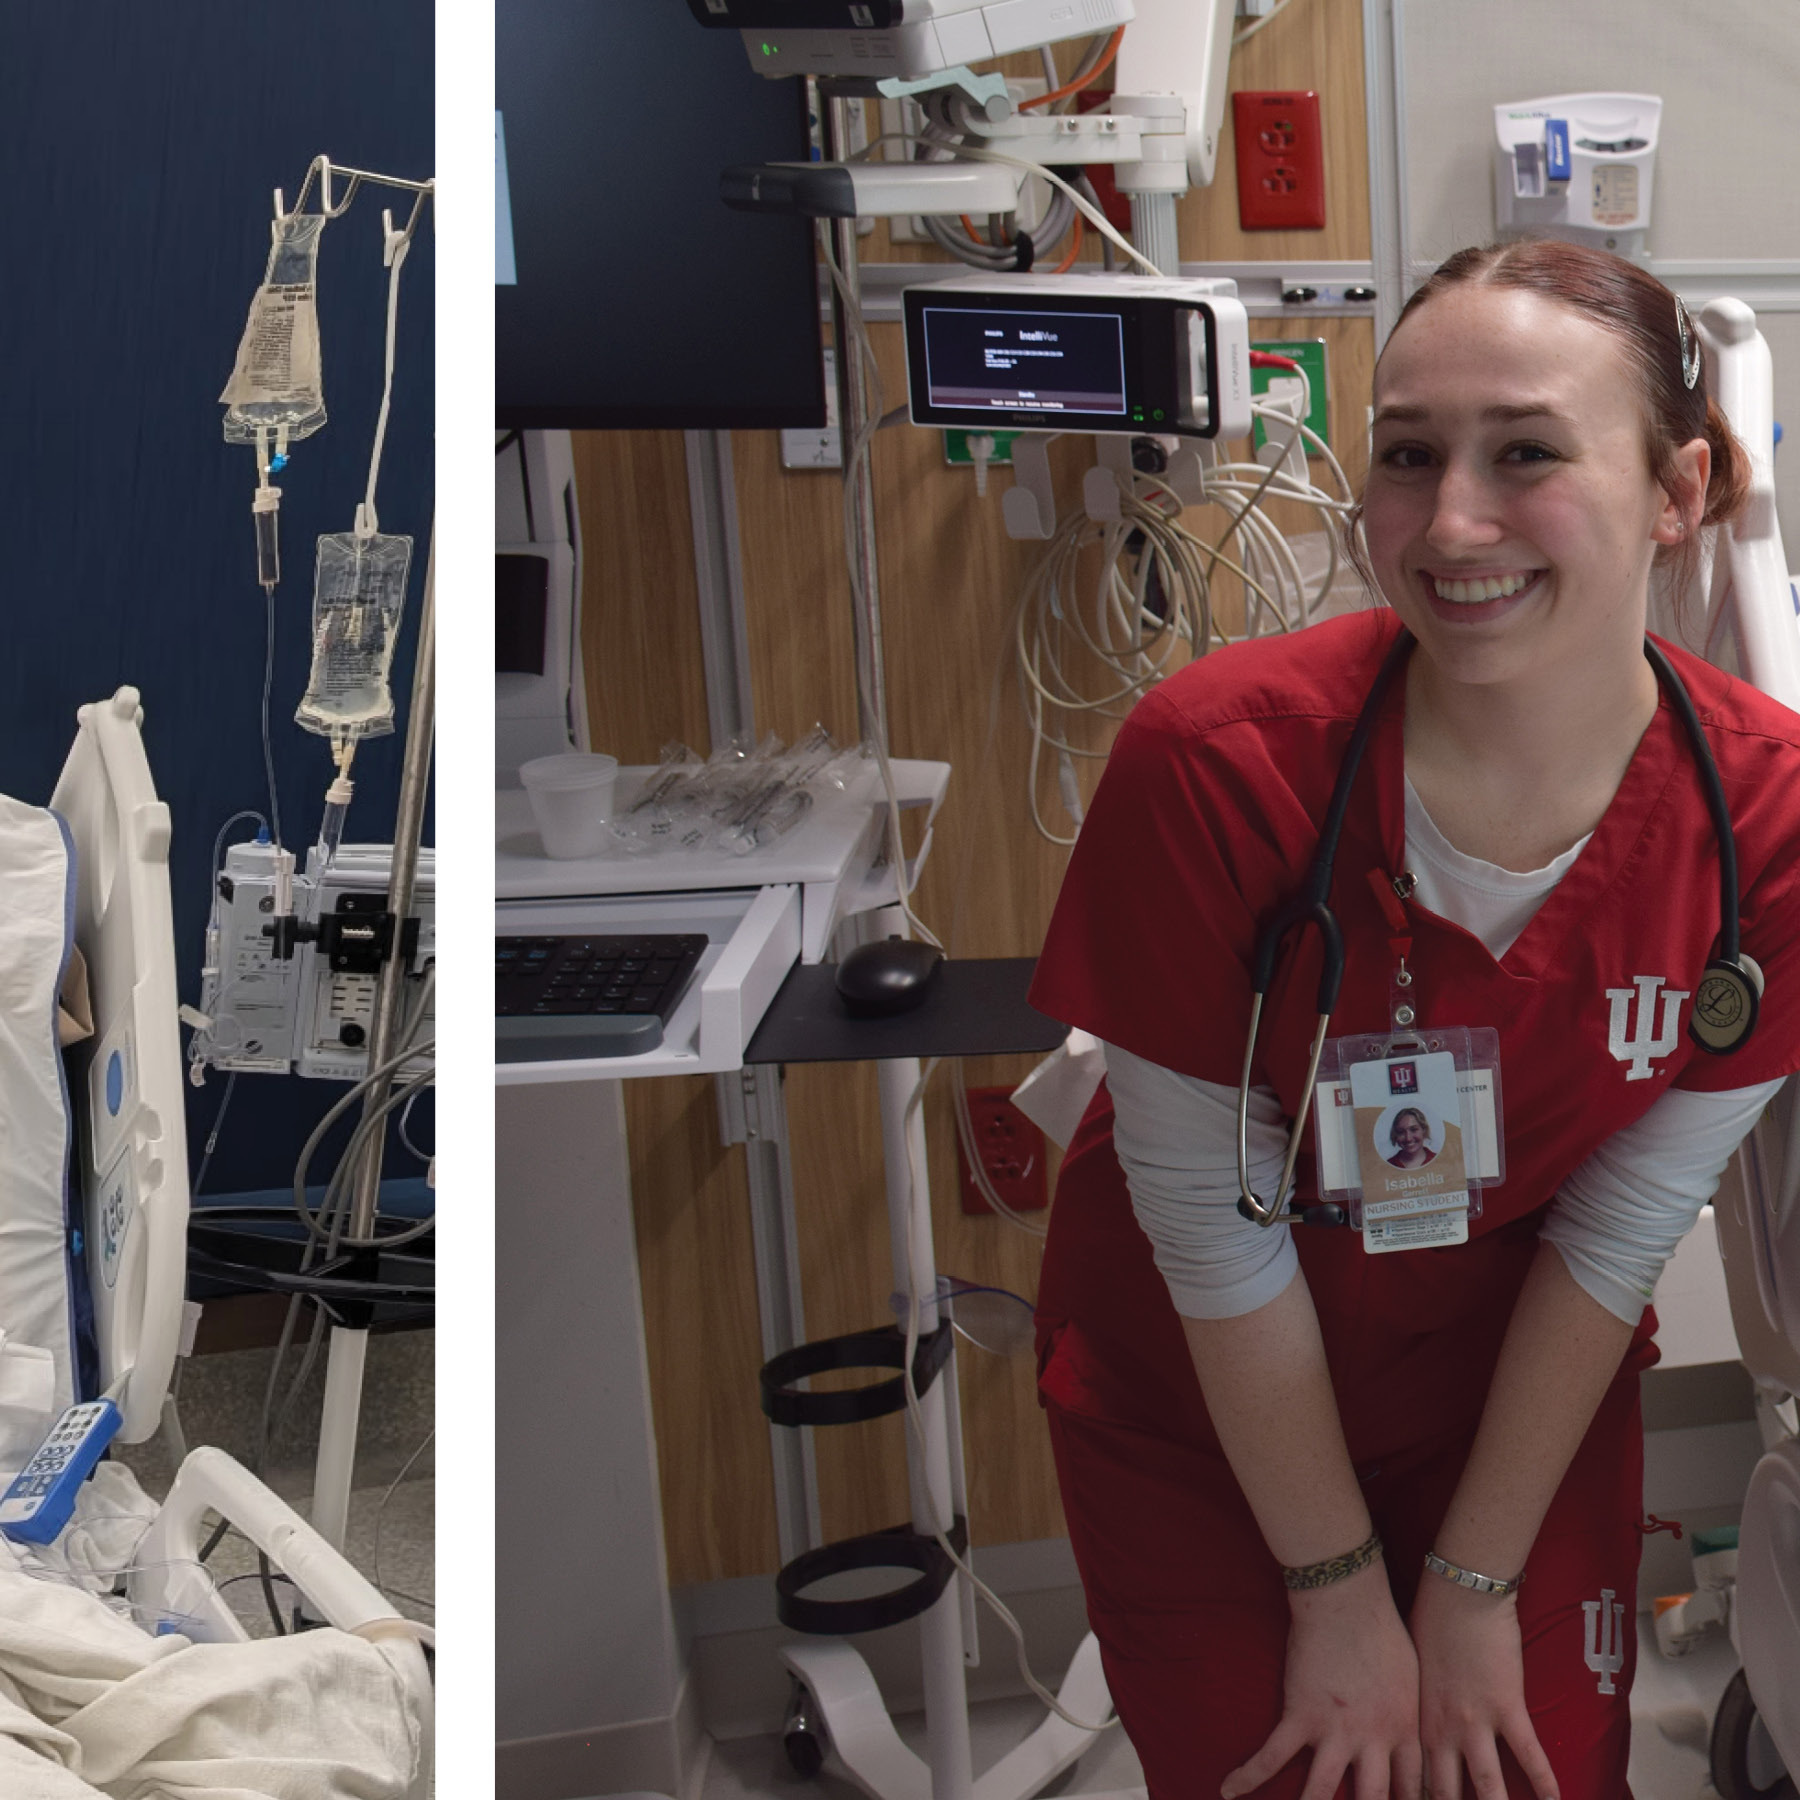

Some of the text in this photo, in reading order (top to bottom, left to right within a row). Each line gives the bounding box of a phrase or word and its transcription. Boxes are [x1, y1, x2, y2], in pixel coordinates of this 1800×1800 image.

[1019, 330, 1058, 341] IntelliVue
[1460, 1084, 1488, 1093] CENTER
[1385, 1172, 1446, 1191] Isabella
[1367, 1192, 1467, 1215] NURSING STUDENT
